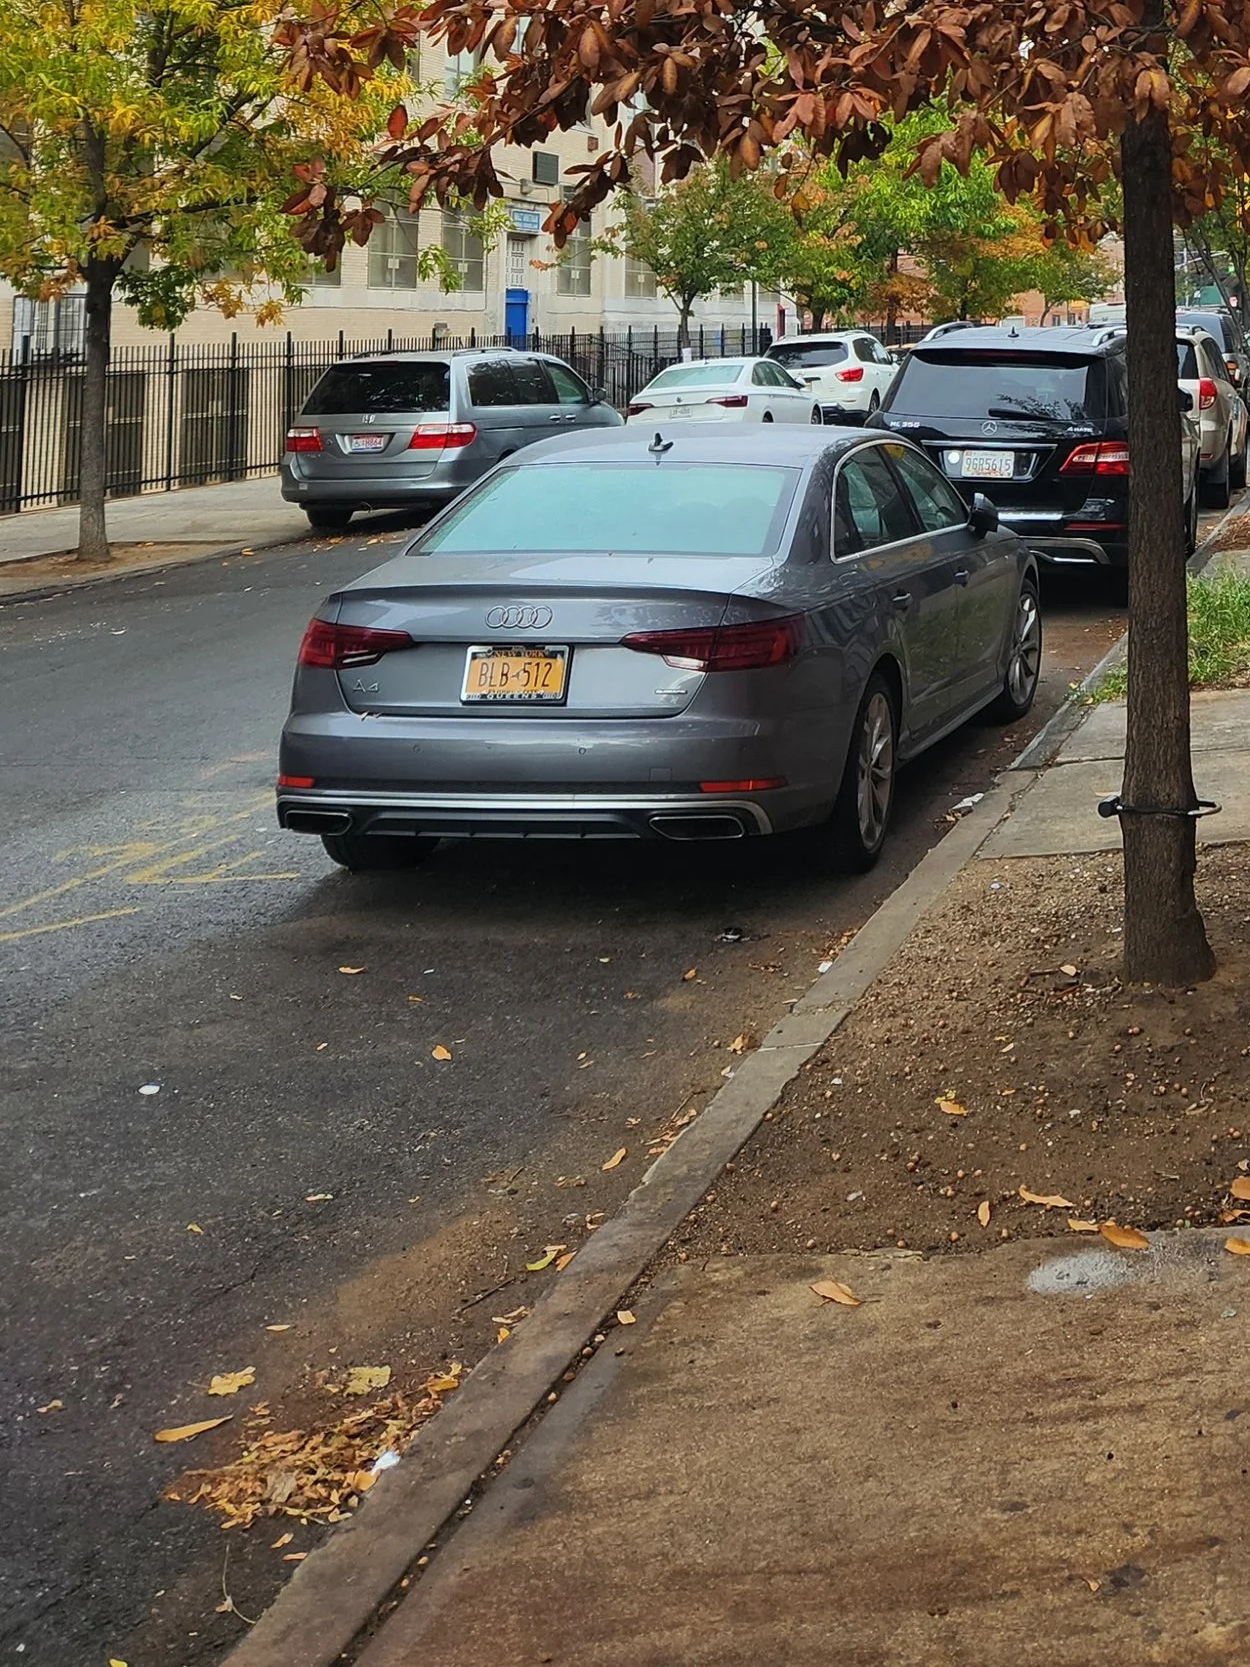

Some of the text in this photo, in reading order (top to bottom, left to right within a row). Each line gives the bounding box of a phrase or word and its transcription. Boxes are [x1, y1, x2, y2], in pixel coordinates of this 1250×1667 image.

[494, 650, 546, 658] NEW YORK
[352, 678, 380, 693] A4
